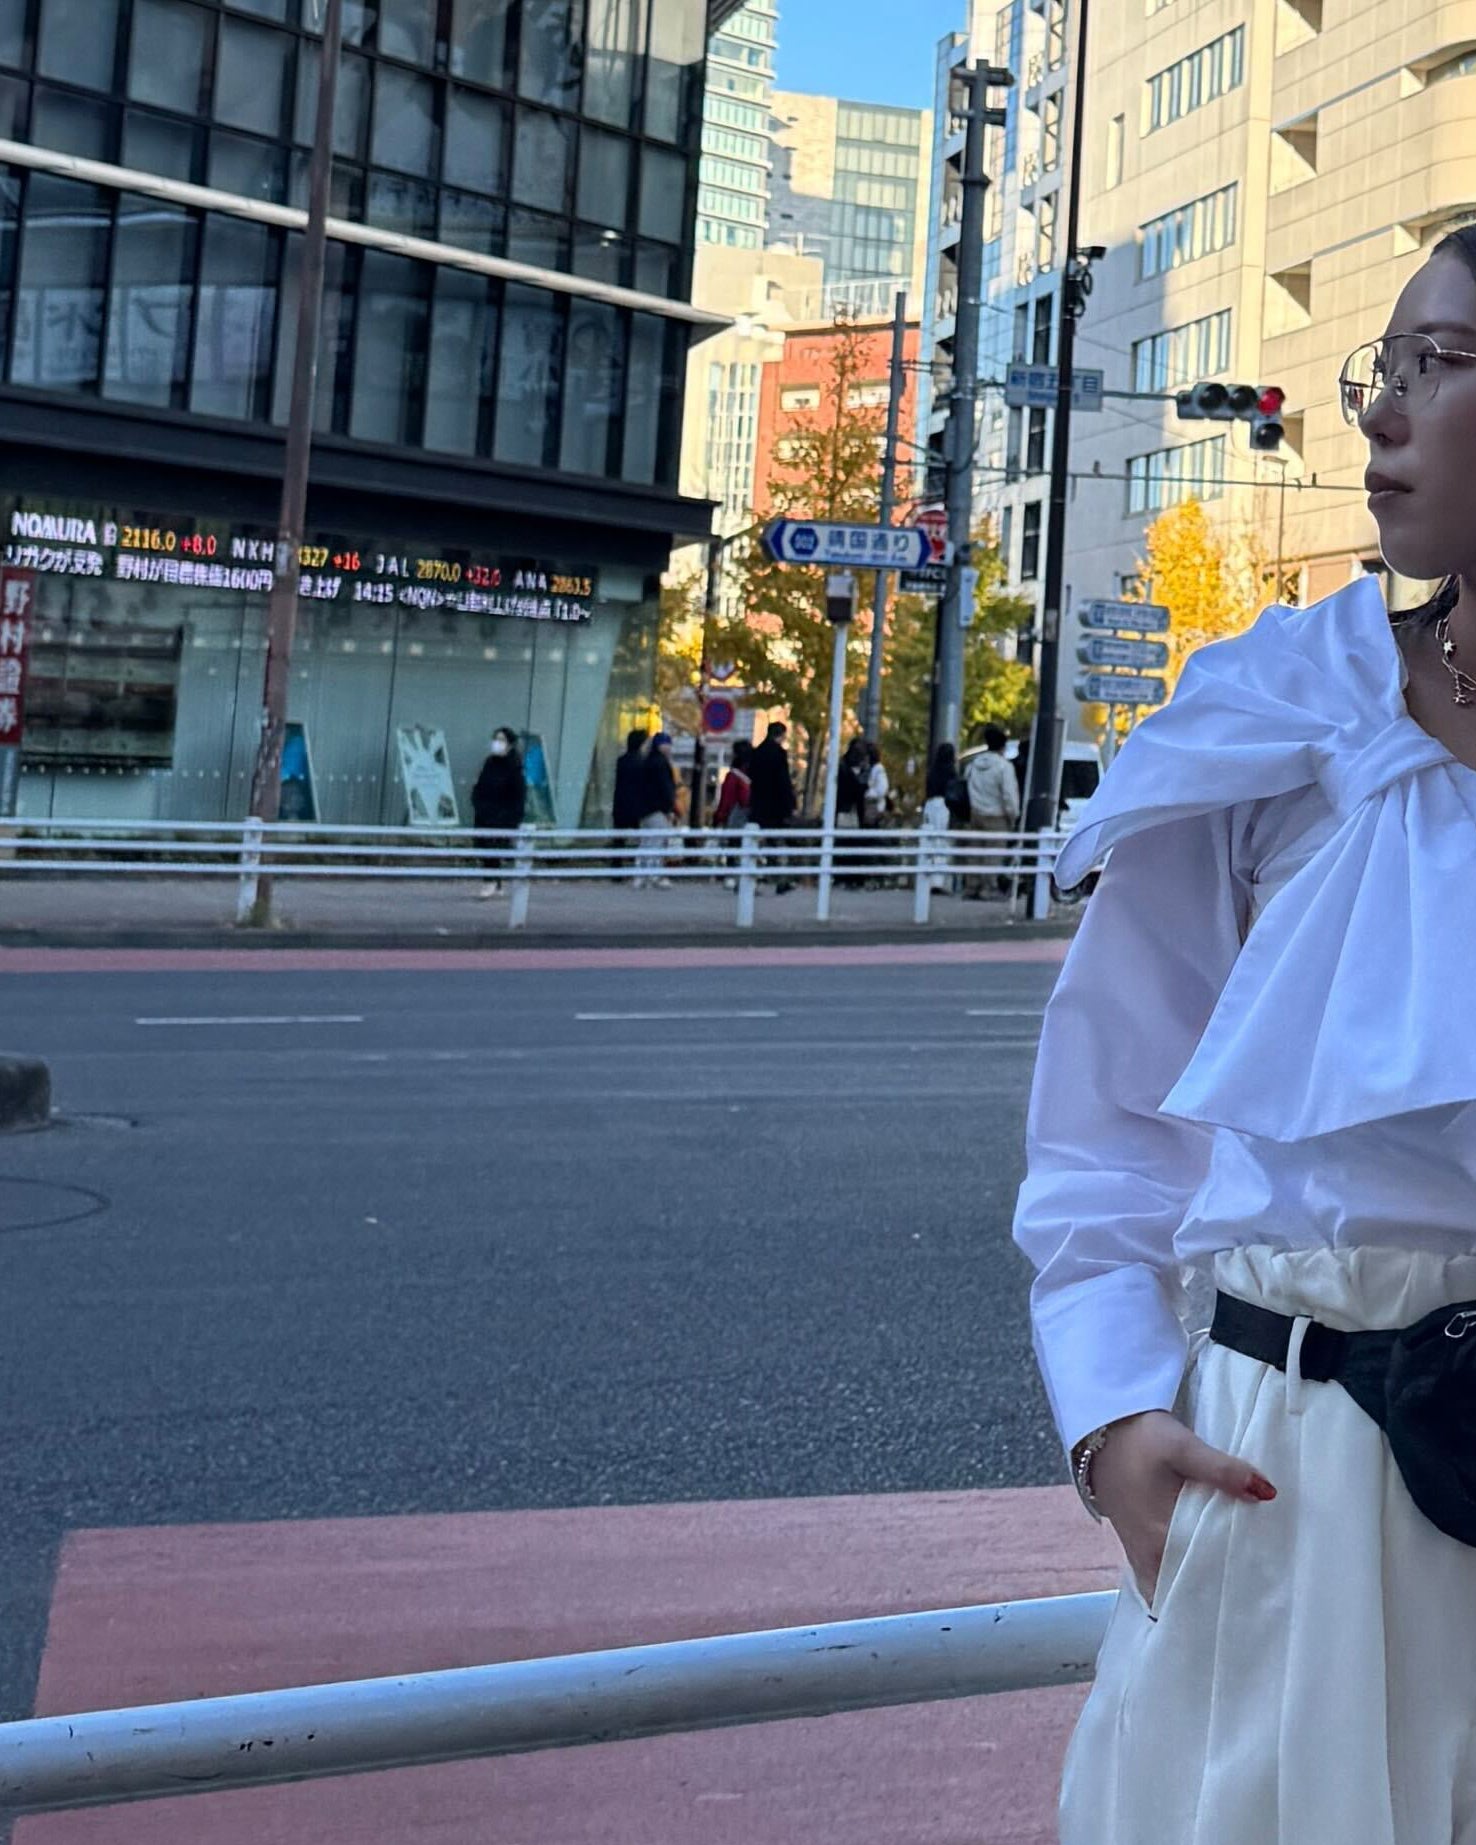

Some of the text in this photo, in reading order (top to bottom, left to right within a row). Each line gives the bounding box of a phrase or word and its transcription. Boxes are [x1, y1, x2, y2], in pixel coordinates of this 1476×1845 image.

[11, 511, 97, 545] NOMURA
[299, 546, 329, 567] 327
[353, 580, 394, 603] 14:15
[513, 570, 547, 592] ANA
